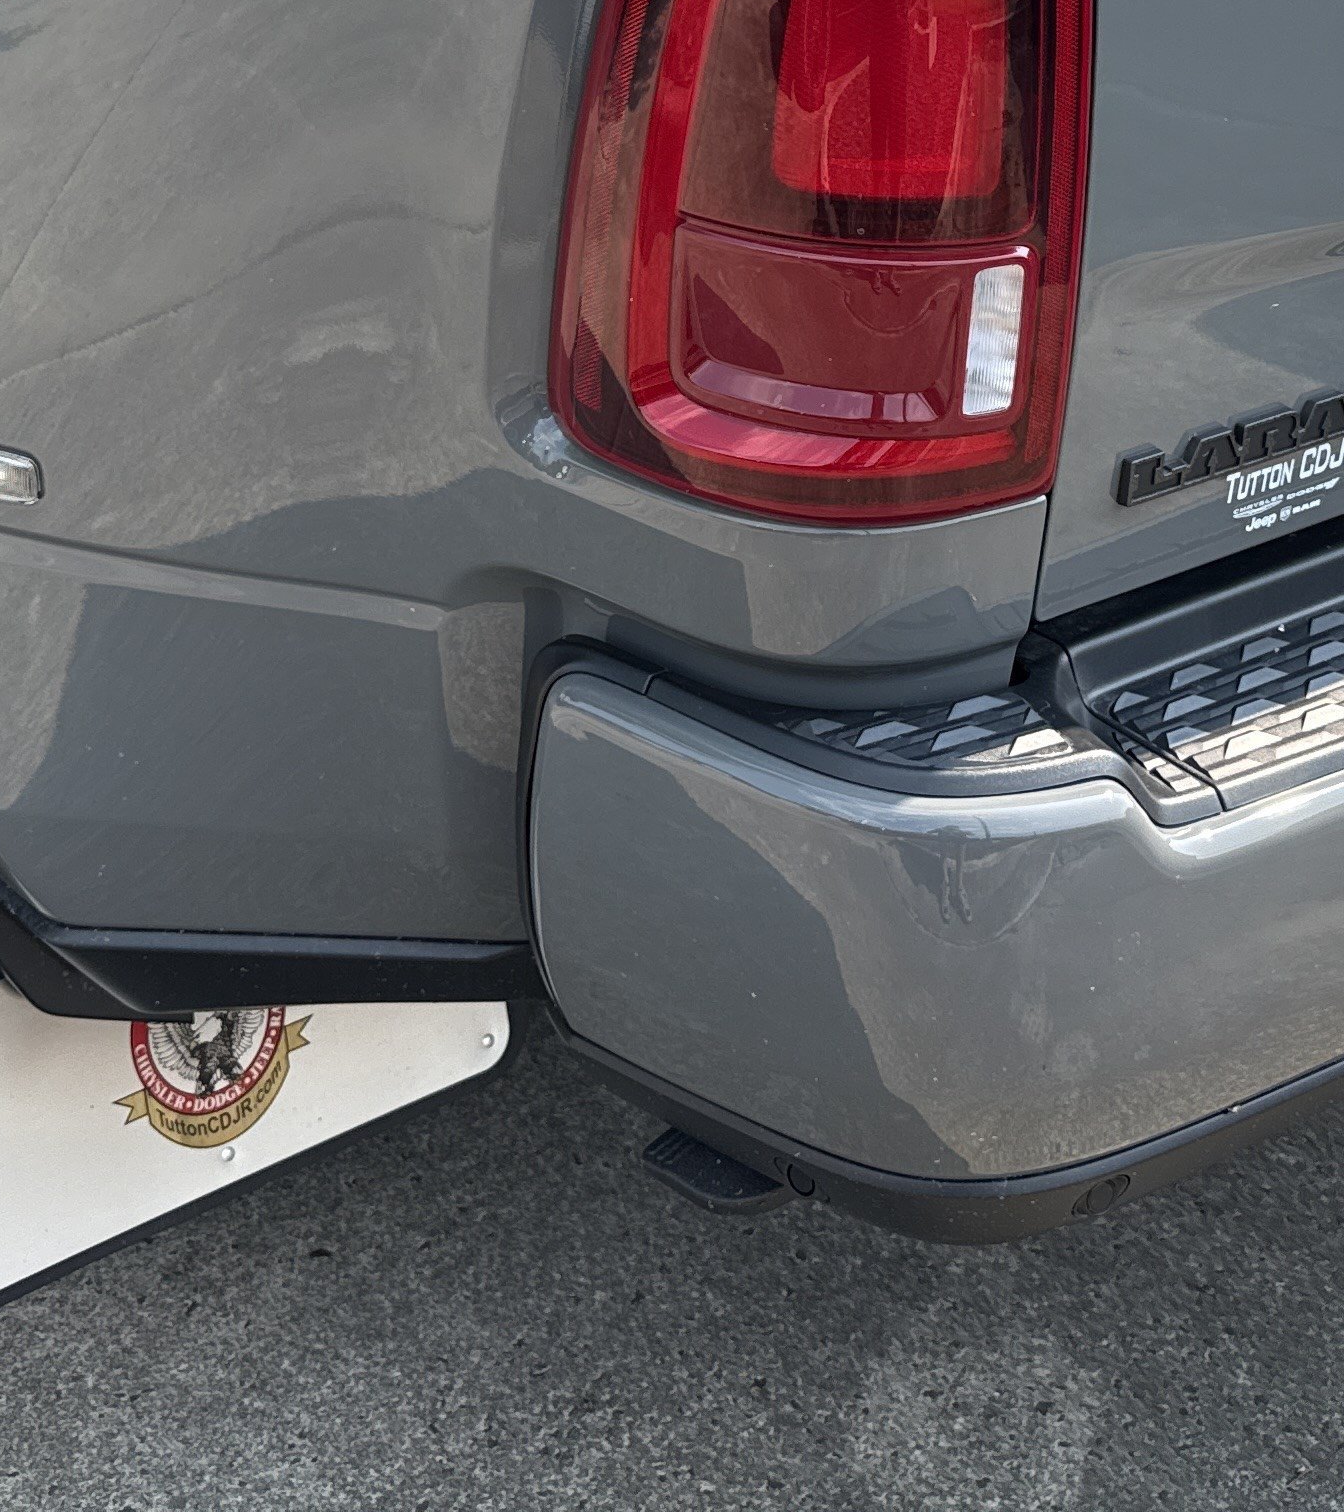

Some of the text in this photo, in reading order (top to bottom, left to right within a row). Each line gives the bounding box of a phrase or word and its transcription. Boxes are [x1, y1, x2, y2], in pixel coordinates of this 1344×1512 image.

[1226, 458, 1295, 504] TUTTON
[1245, 513, 1277, 532] Jeep
[133, 1043, 187, 1110] CHRYSLER
[193, 1081, 246, 1111] DODGE
[250, 1038, 277, 1080] JEEP
[156, 1060, 284, 1138] TuttonCDJR.com
